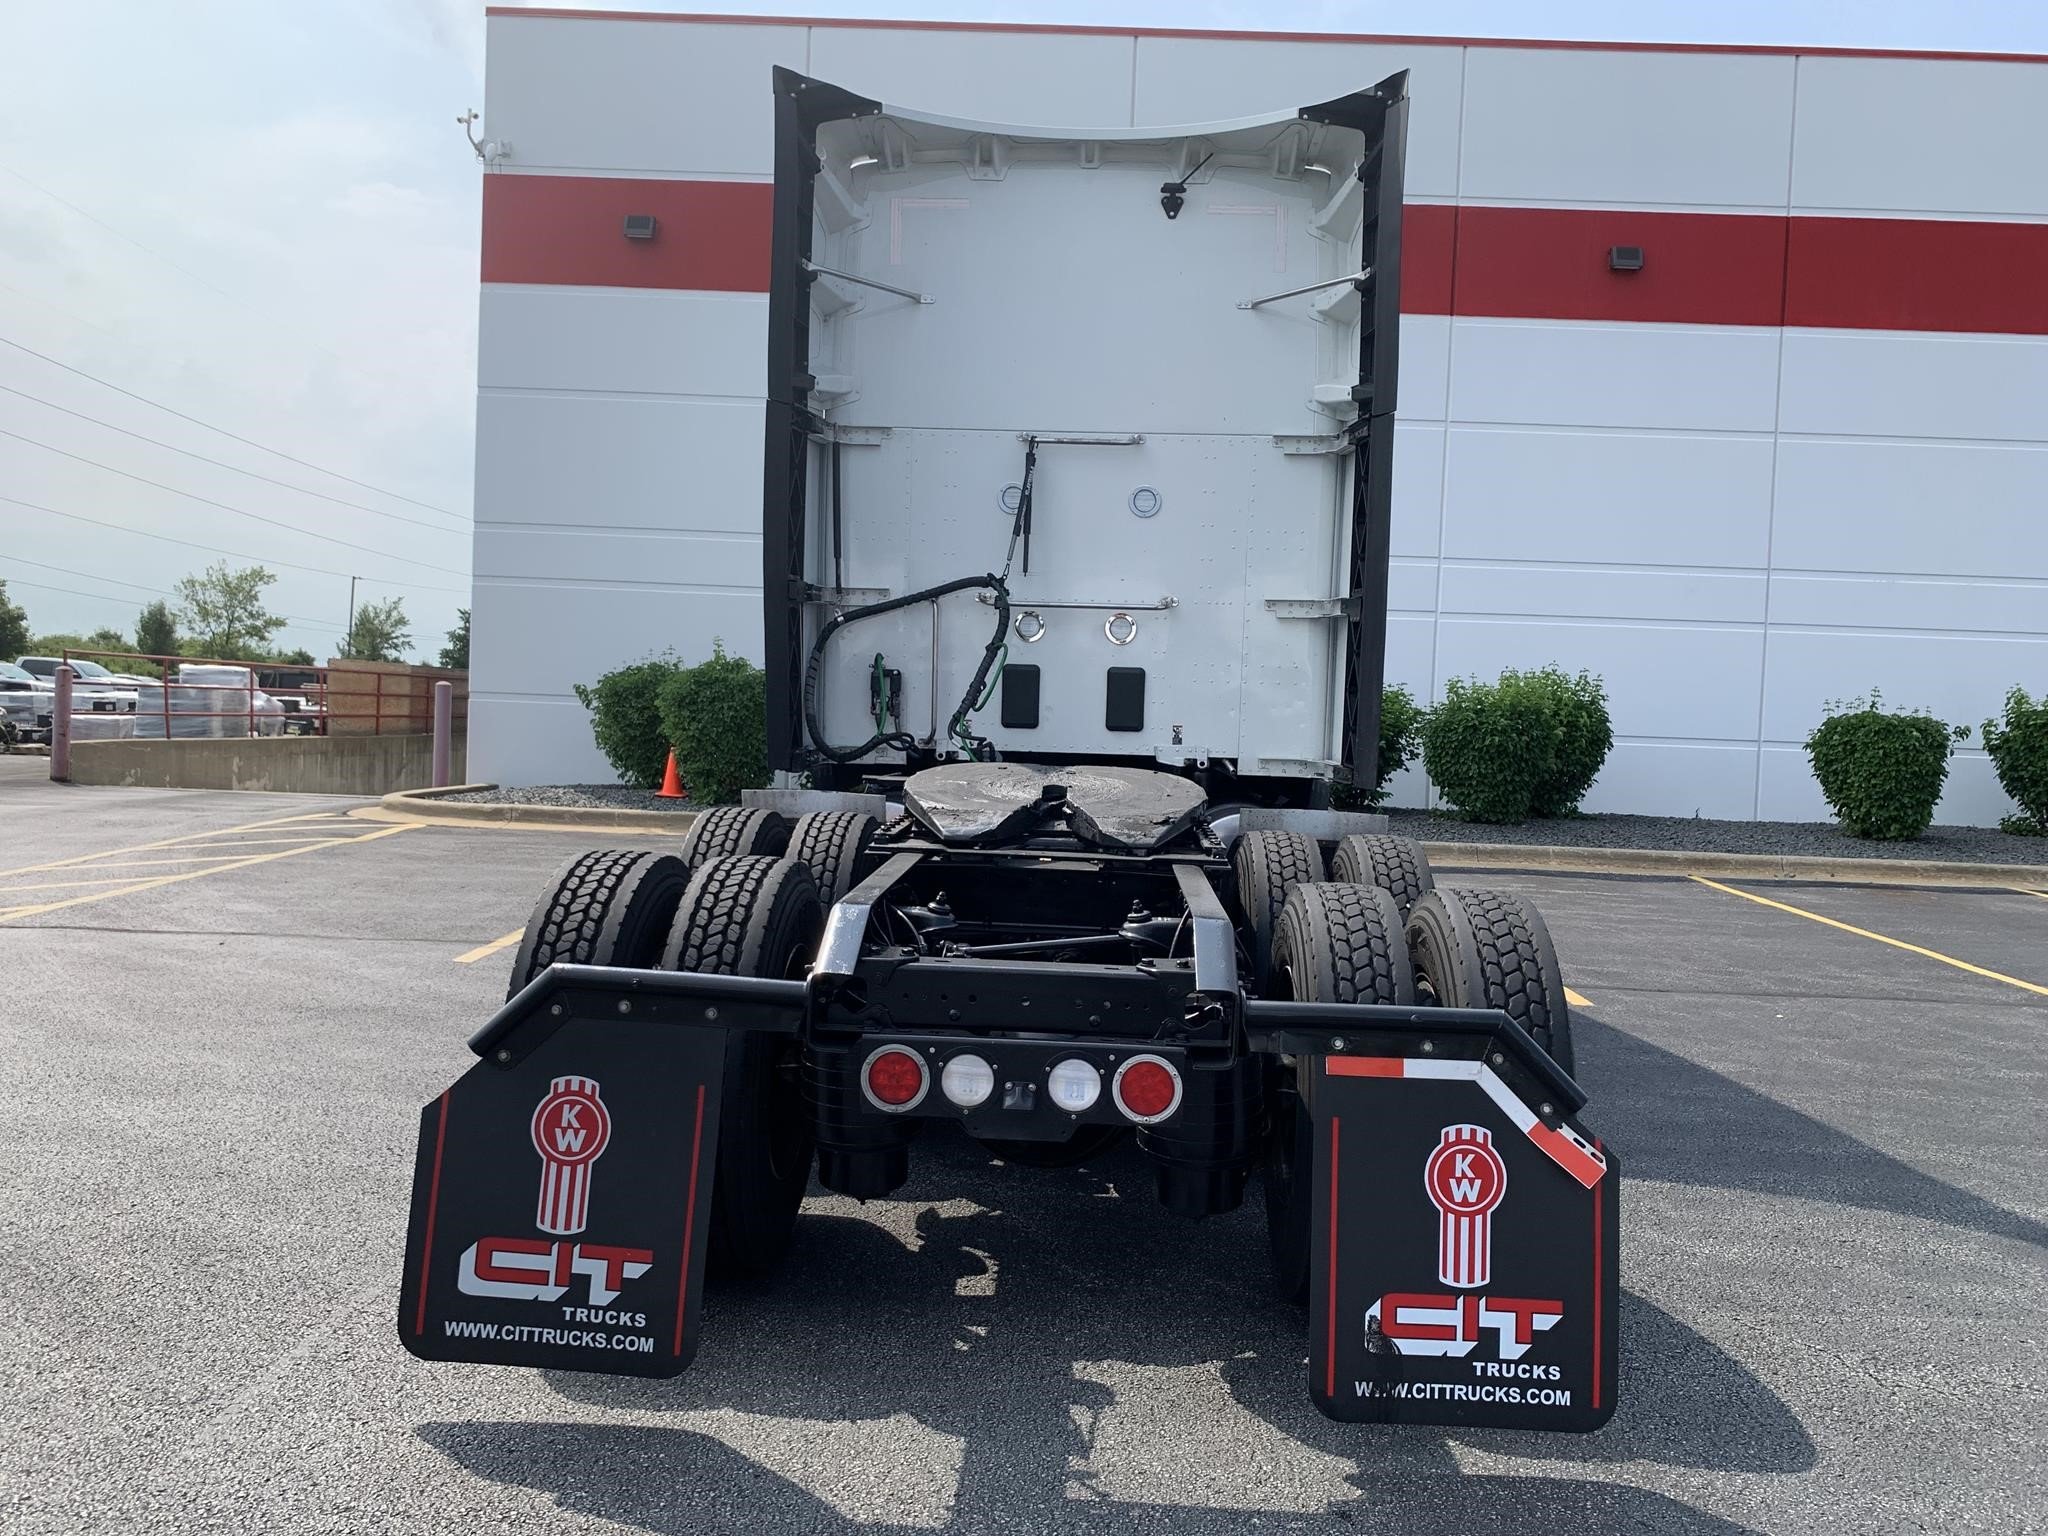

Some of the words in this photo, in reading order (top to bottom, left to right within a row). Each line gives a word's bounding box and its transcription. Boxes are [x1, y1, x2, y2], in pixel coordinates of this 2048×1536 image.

[561, 1104, 583, 1128] K
[555, 1128, 587, 1152] W
[1455, 1153, 1476, 1178] K
[1449, 1178, 1481, 1203] W
[457, 1237, 654, 1306] CIT
[562, 1307, 647, 1327] TRUCKS
[1364, 1293, 1564, 1360] CIT
[445, 1321, 654, 1353] WWW.CITTRUCKS.COM
[1473, 1362, 1561, 1380] TRUCKS
[1355, 1381, 1571, 1406] WW.CITTRUCKS.COM
